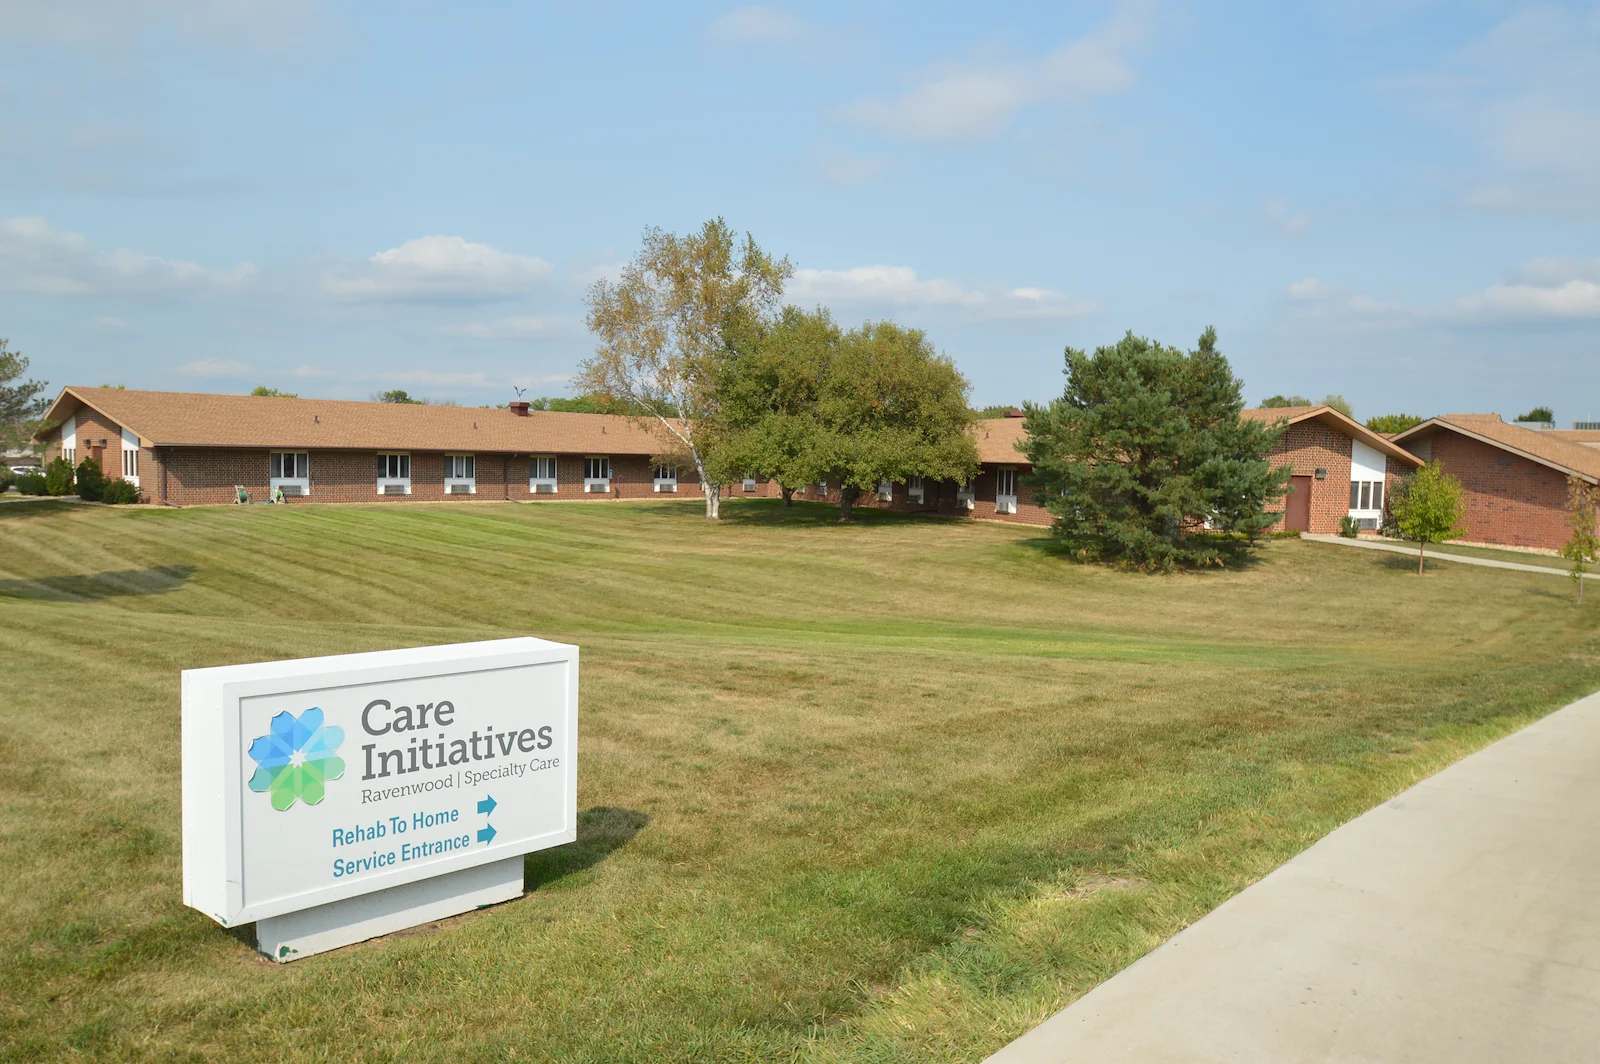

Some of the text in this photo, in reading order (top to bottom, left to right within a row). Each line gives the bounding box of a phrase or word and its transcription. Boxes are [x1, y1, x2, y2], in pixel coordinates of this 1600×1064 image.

[361, 699, 455, 736] Care
[361, 724, 553, 781] Initiatives
[361, 774, 453, 804] Ravenwood
[464, 761, 527, 787] Specialty
[529, 757, 560, 772] Care
[332, 807, 459, 848] Rehab To Home
[332, 834, 470, 878] Service Entrance
